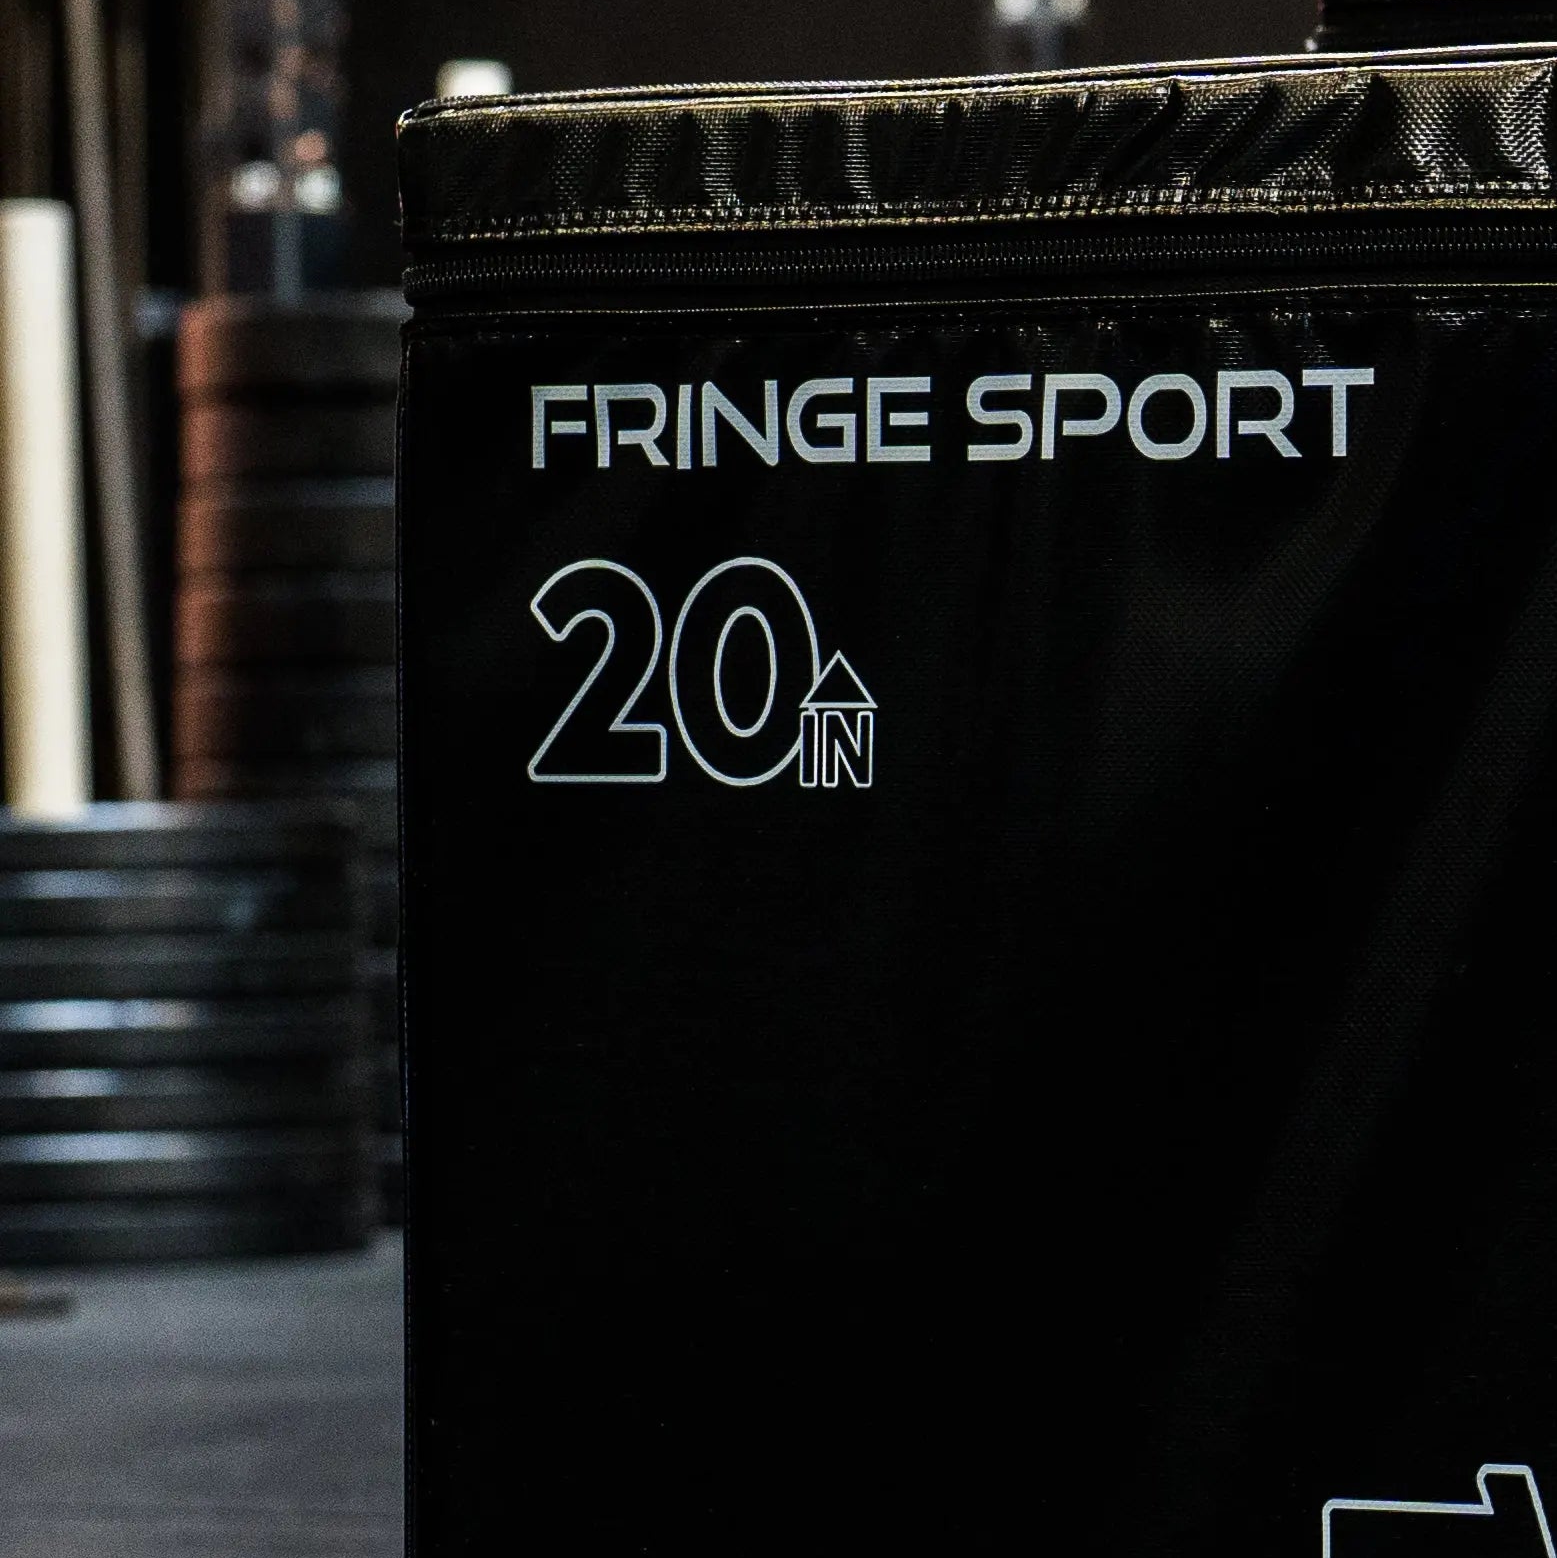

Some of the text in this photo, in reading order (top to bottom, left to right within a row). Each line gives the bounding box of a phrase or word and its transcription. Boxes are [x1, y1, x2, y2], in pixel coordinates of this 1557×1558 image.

[531, 367, 1375, 470] FRINGE SPORT
[527, 556, 821, 787] 20
